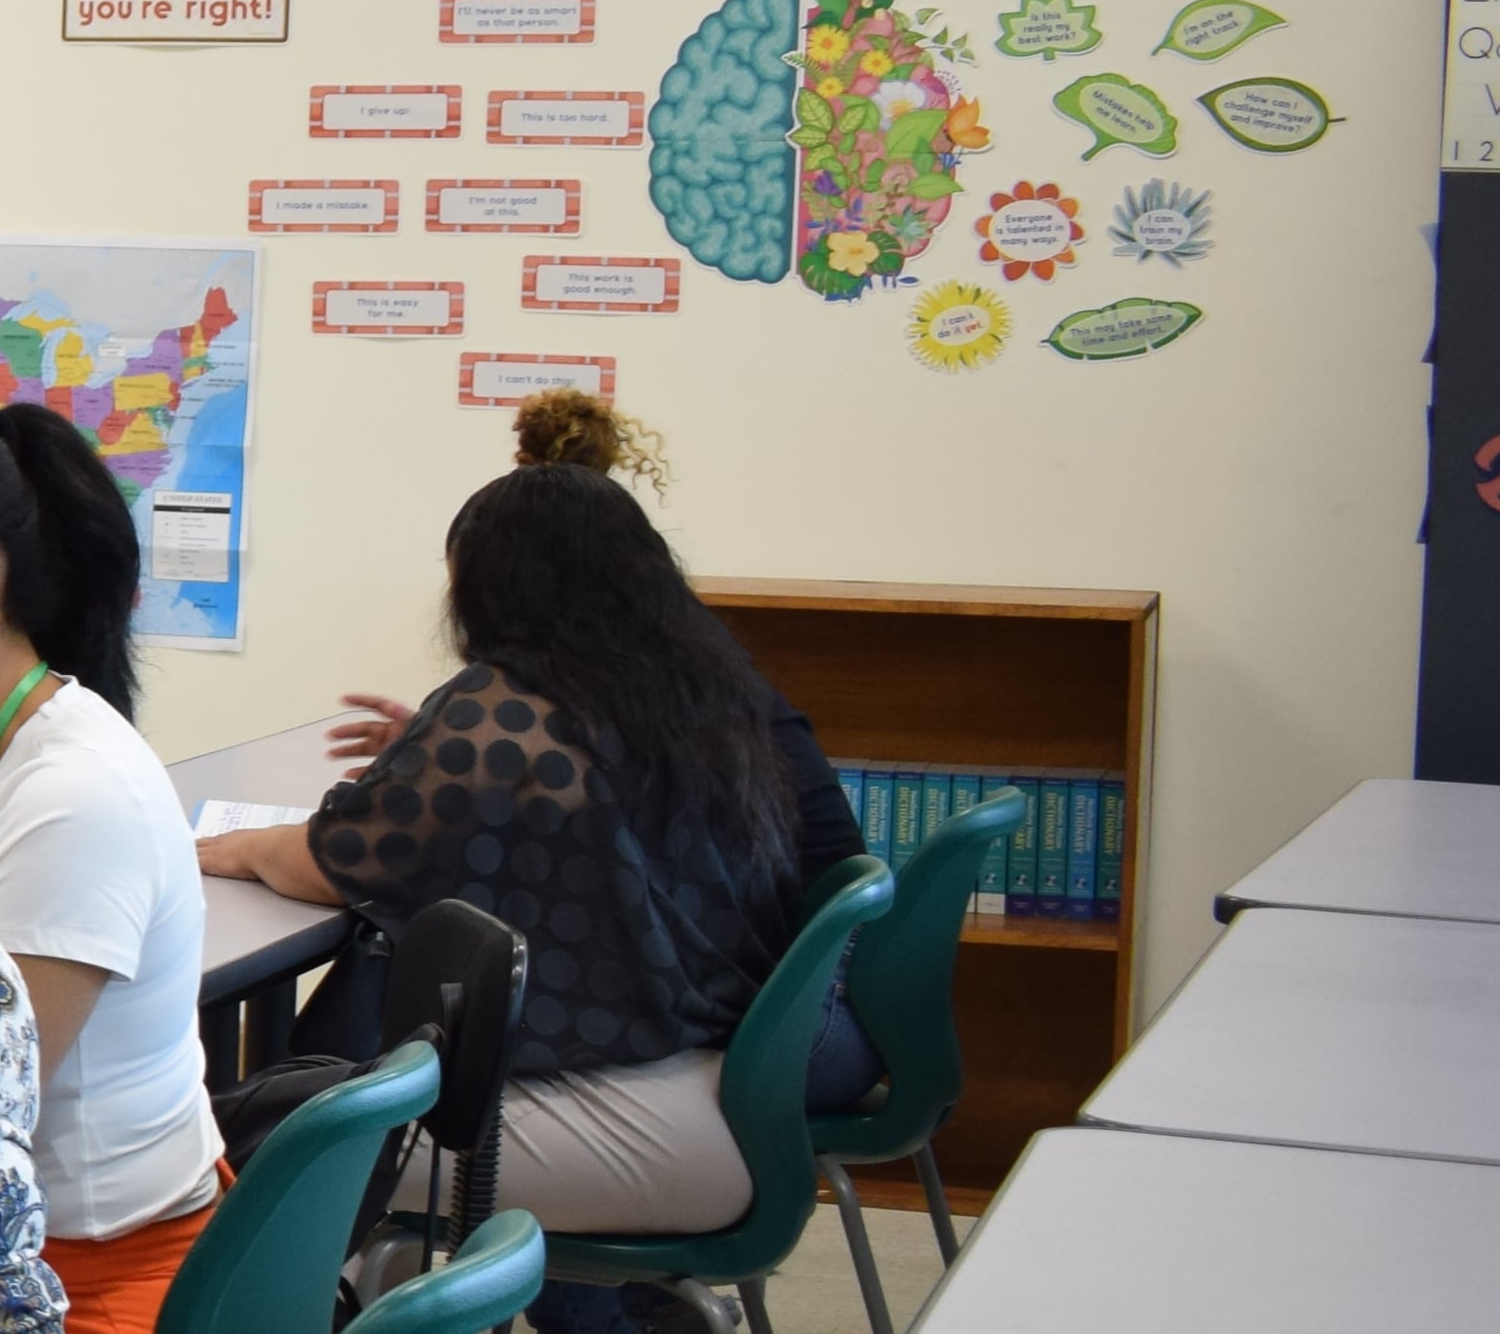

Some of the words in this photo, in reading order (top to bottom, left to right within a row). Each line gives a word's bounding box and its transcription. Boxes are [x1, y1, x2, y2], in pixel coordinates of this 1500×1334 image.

[1454, 140, 1460, 161] 1
[1479, 141, 1494, 162] 2
[1005, 214, 1052, 223] Everyone
